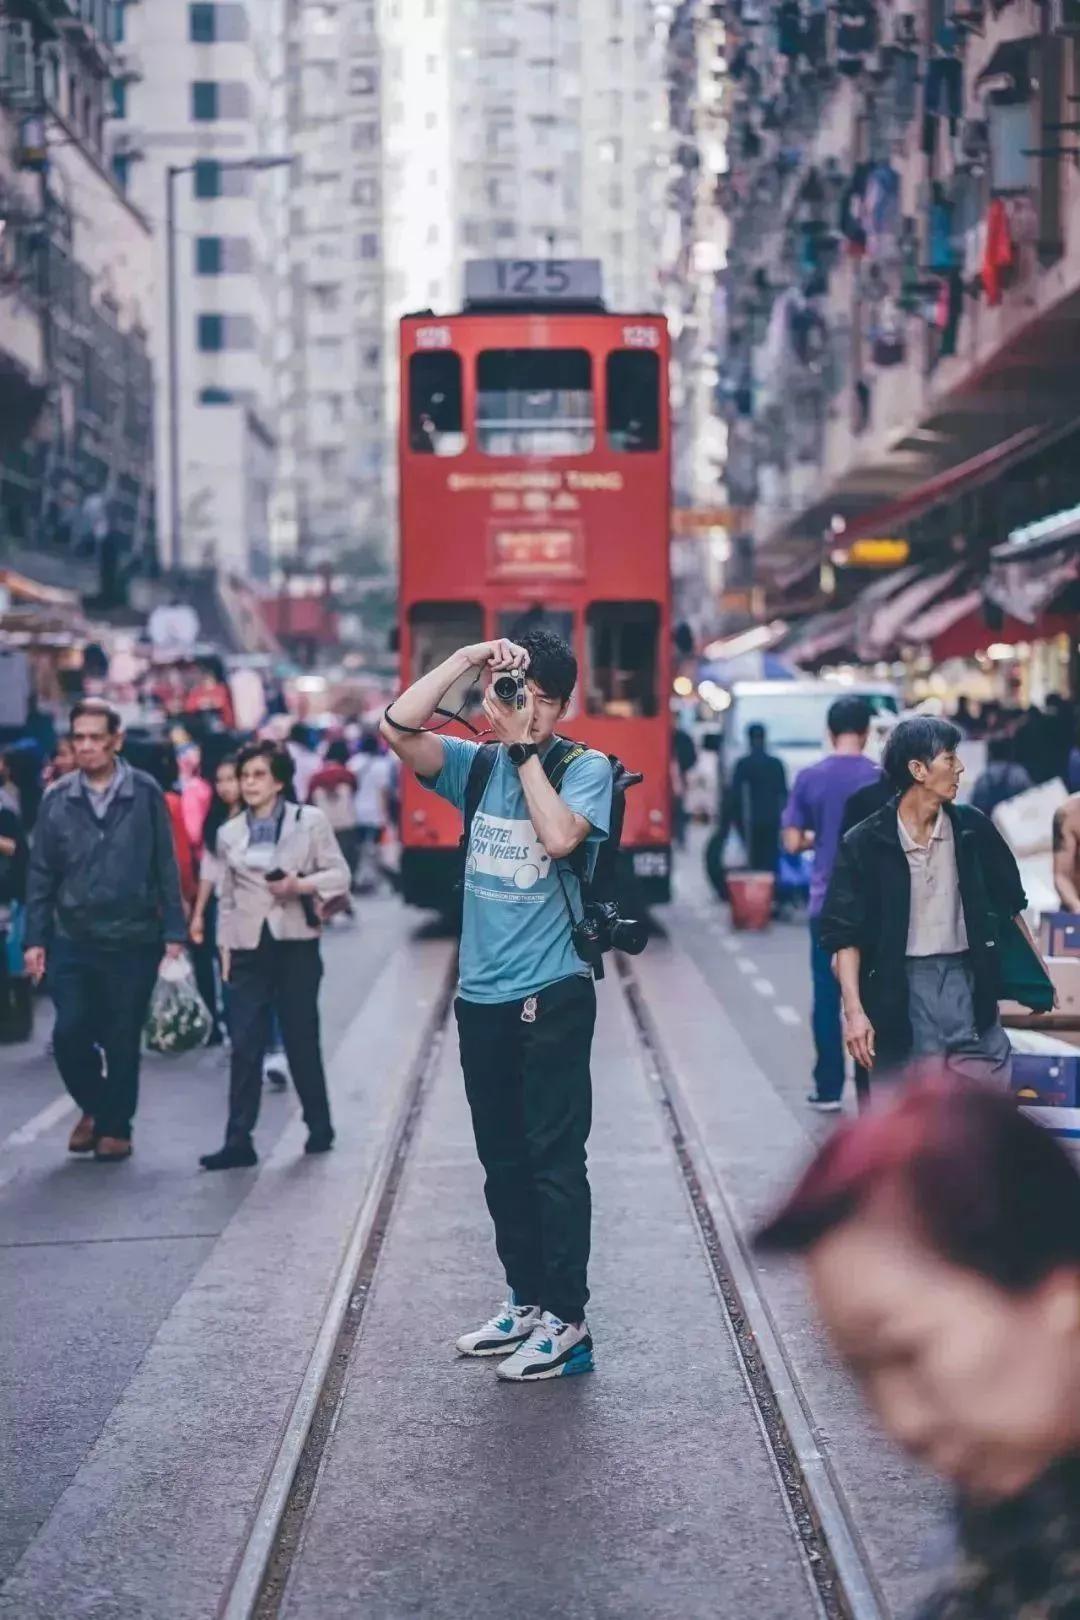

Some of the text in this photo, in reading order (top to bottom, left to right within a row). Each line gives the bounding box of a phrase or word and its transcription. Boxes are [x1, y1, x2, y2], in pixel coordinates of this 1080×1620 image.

[496, 259, 571, 294] 125
[563, 747, 585, 764] Nikon
[471, 838, 530, 861] ON WHEELS
